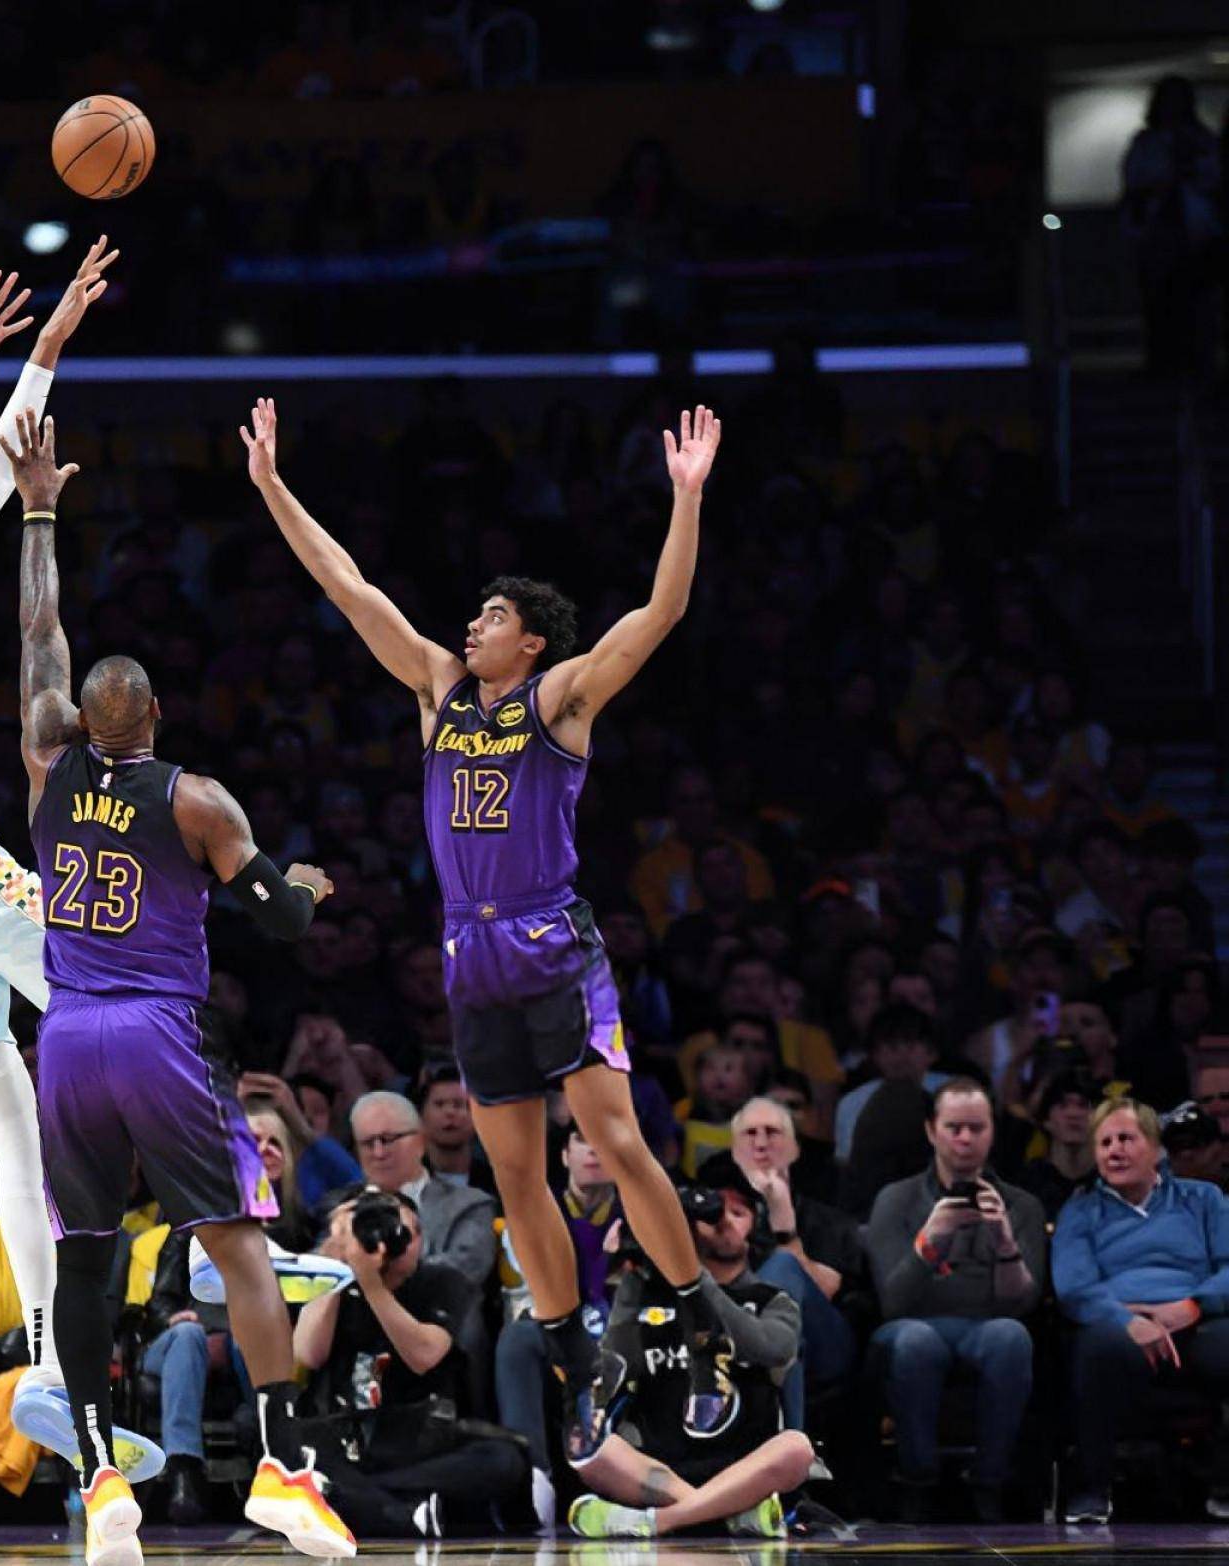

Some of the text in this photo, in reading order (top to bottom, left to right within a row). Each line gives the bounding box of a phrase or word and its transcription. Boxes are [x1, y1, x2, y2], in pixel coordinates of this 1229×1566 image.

[72, 790, 137, 834] JAMES
[451, 768, 509, 831] 12
[47, 842, 144, 934] 23
